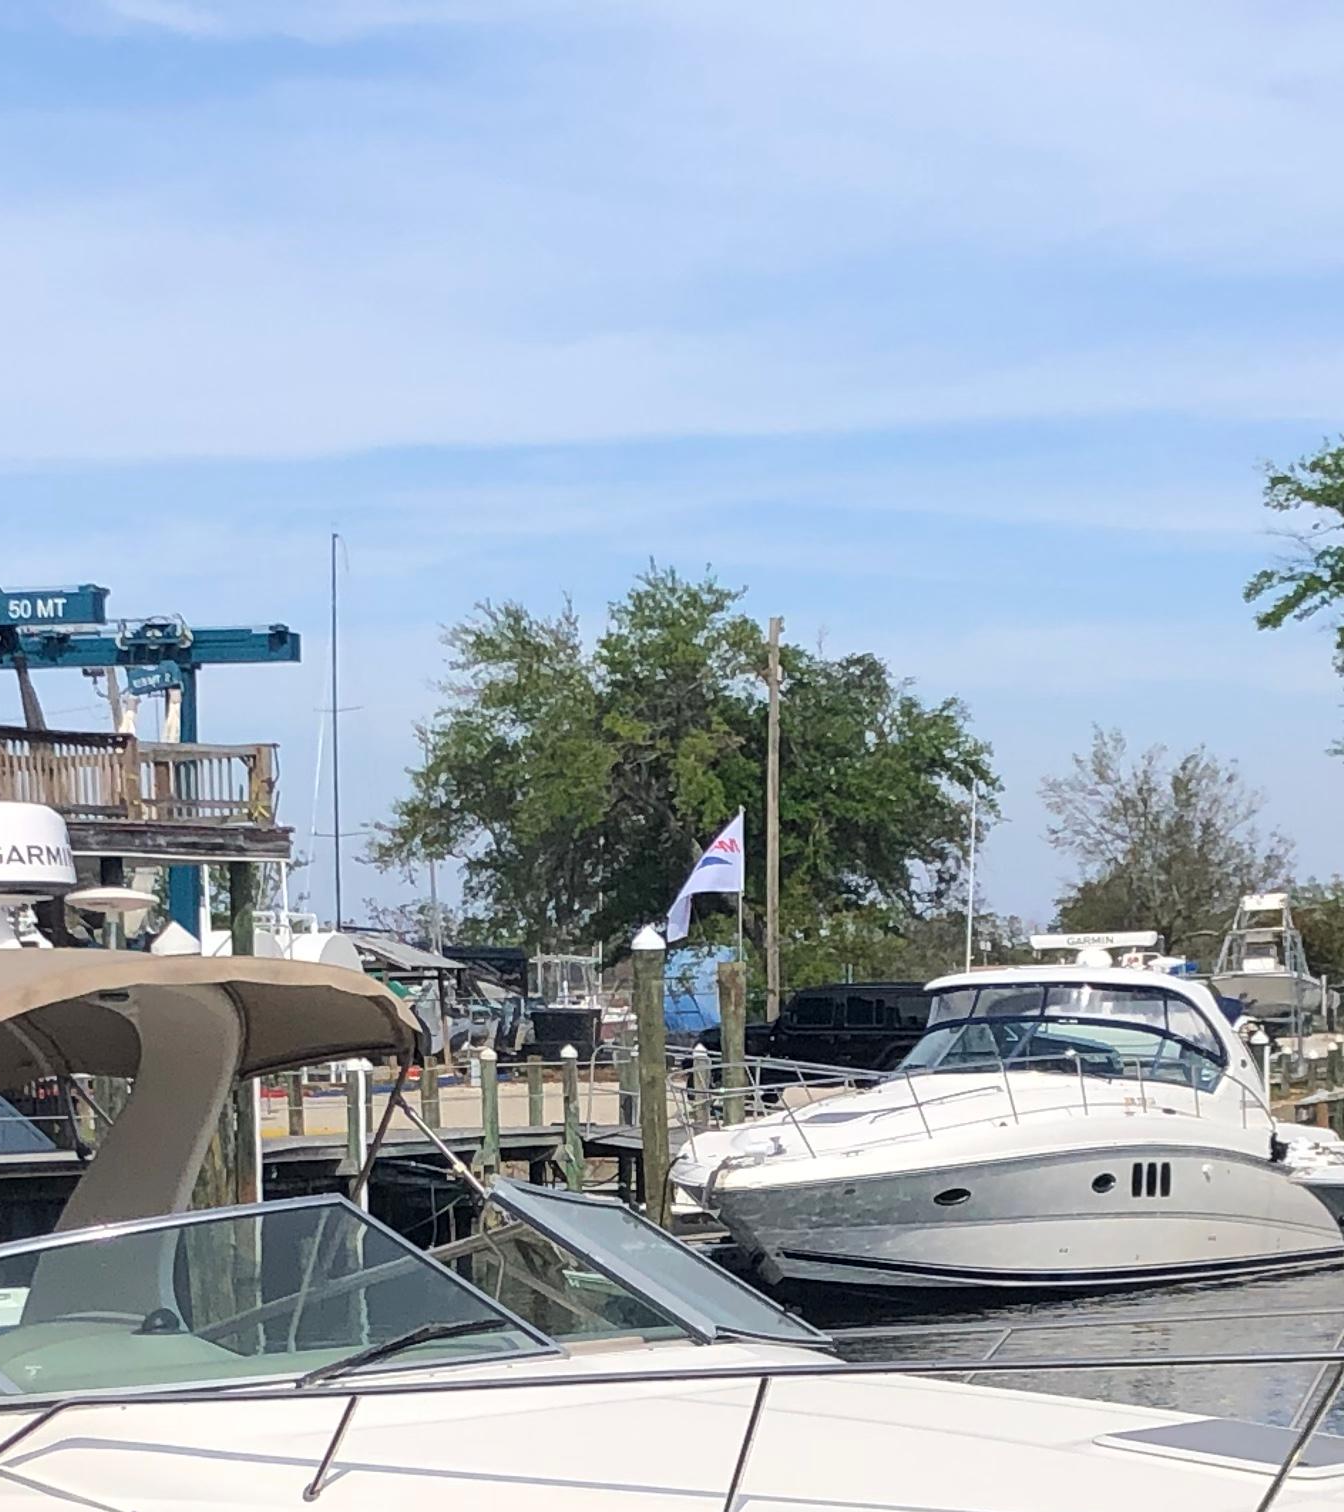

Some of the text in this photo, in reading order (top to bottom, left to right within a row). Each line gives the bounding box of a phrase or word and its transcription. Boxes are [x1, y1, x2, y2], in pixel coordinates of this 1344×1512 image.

[8, 598, 67, 619] 50 MT
[1067, 936, 1115, 945] GARMIN
